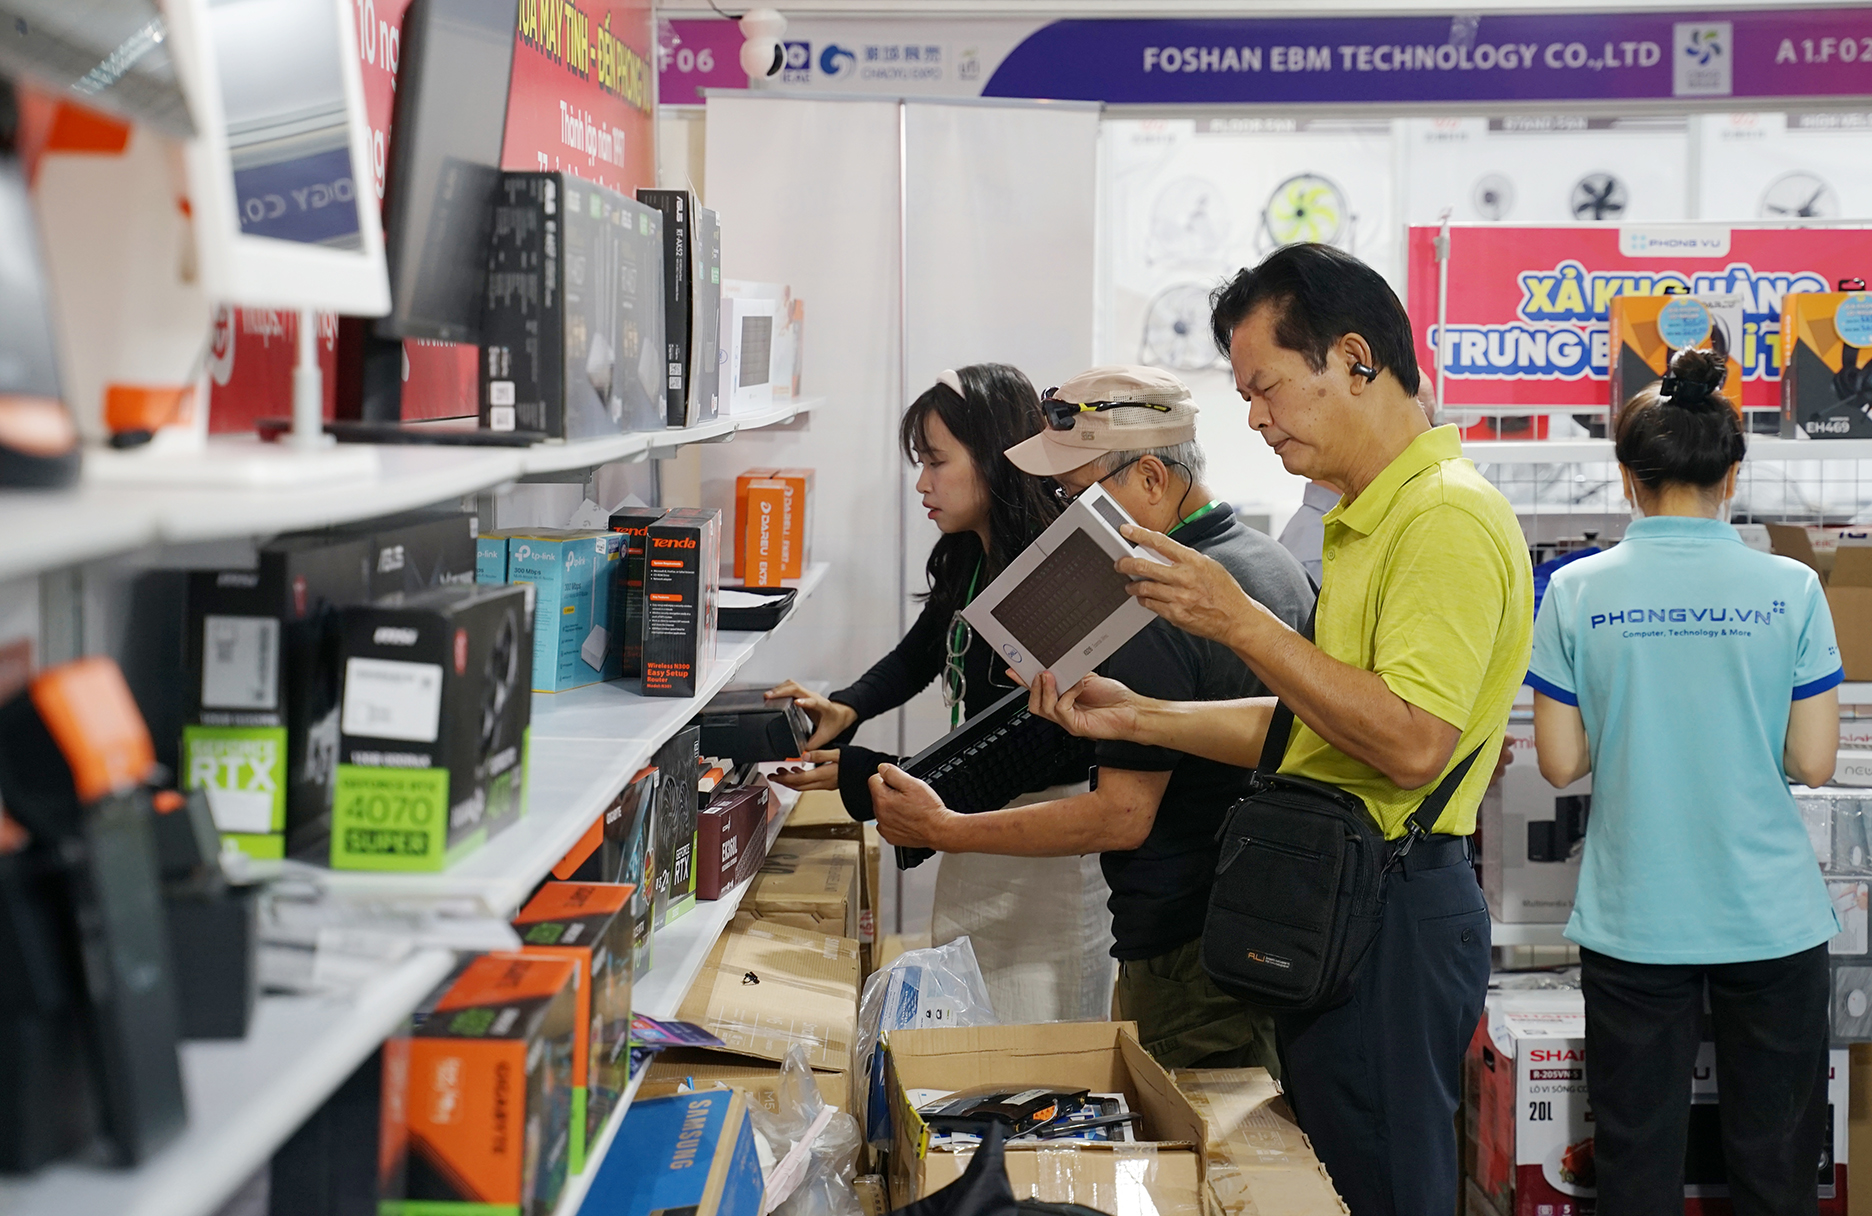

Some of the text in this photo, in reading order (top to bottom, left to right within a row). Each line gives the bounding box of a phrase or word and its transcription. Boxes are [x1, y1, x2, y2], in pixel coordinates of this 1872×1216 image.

[519, 0, 538, 42] UA
[1143, 41, 1661, 72] FOSHAN EBM TECHNOLOGY CO.,LTD
[676, 195, 684, 222] ASUS
[1649, 239, 1697, 248] PHONG
[1525, 267, 1586, 313] XẢ
[1435, 329, 1582, 367] TRƯNG
[1805, 421, 1850, 434] EH469
[783, 497, 793, 535] DAREU
[477, 550, 498, 558] p-link
[652, 537, 697, 549] Tenda
[758, 515, 771, 586] DAREU EK75
[531, 552, 556, 561] tp-link
[1590, 607, 1772, 629] PHONGVU.VN
[1622, 630, 1666, 639] Computer,
[1668, 629, 1719, 638] Technology
[1729, 629, 1752, 637] More
[647, 669, 689, 679] Easy Setup
[1513, 735, 1535, 749] mi
[190, 757, 277, 791] RTX
[346, 795, 434, 825] 4070
[346, 831, 428, 854] SUPER
[675, 843, 690, 861] GEFORCE
[673, 854, 689, 886] RTX
[764, 1090, 775, 1110] M5
[1529, 1101, 1553, 1121] 20L
[669, 1098, 712, 1170] SAMSUNG
